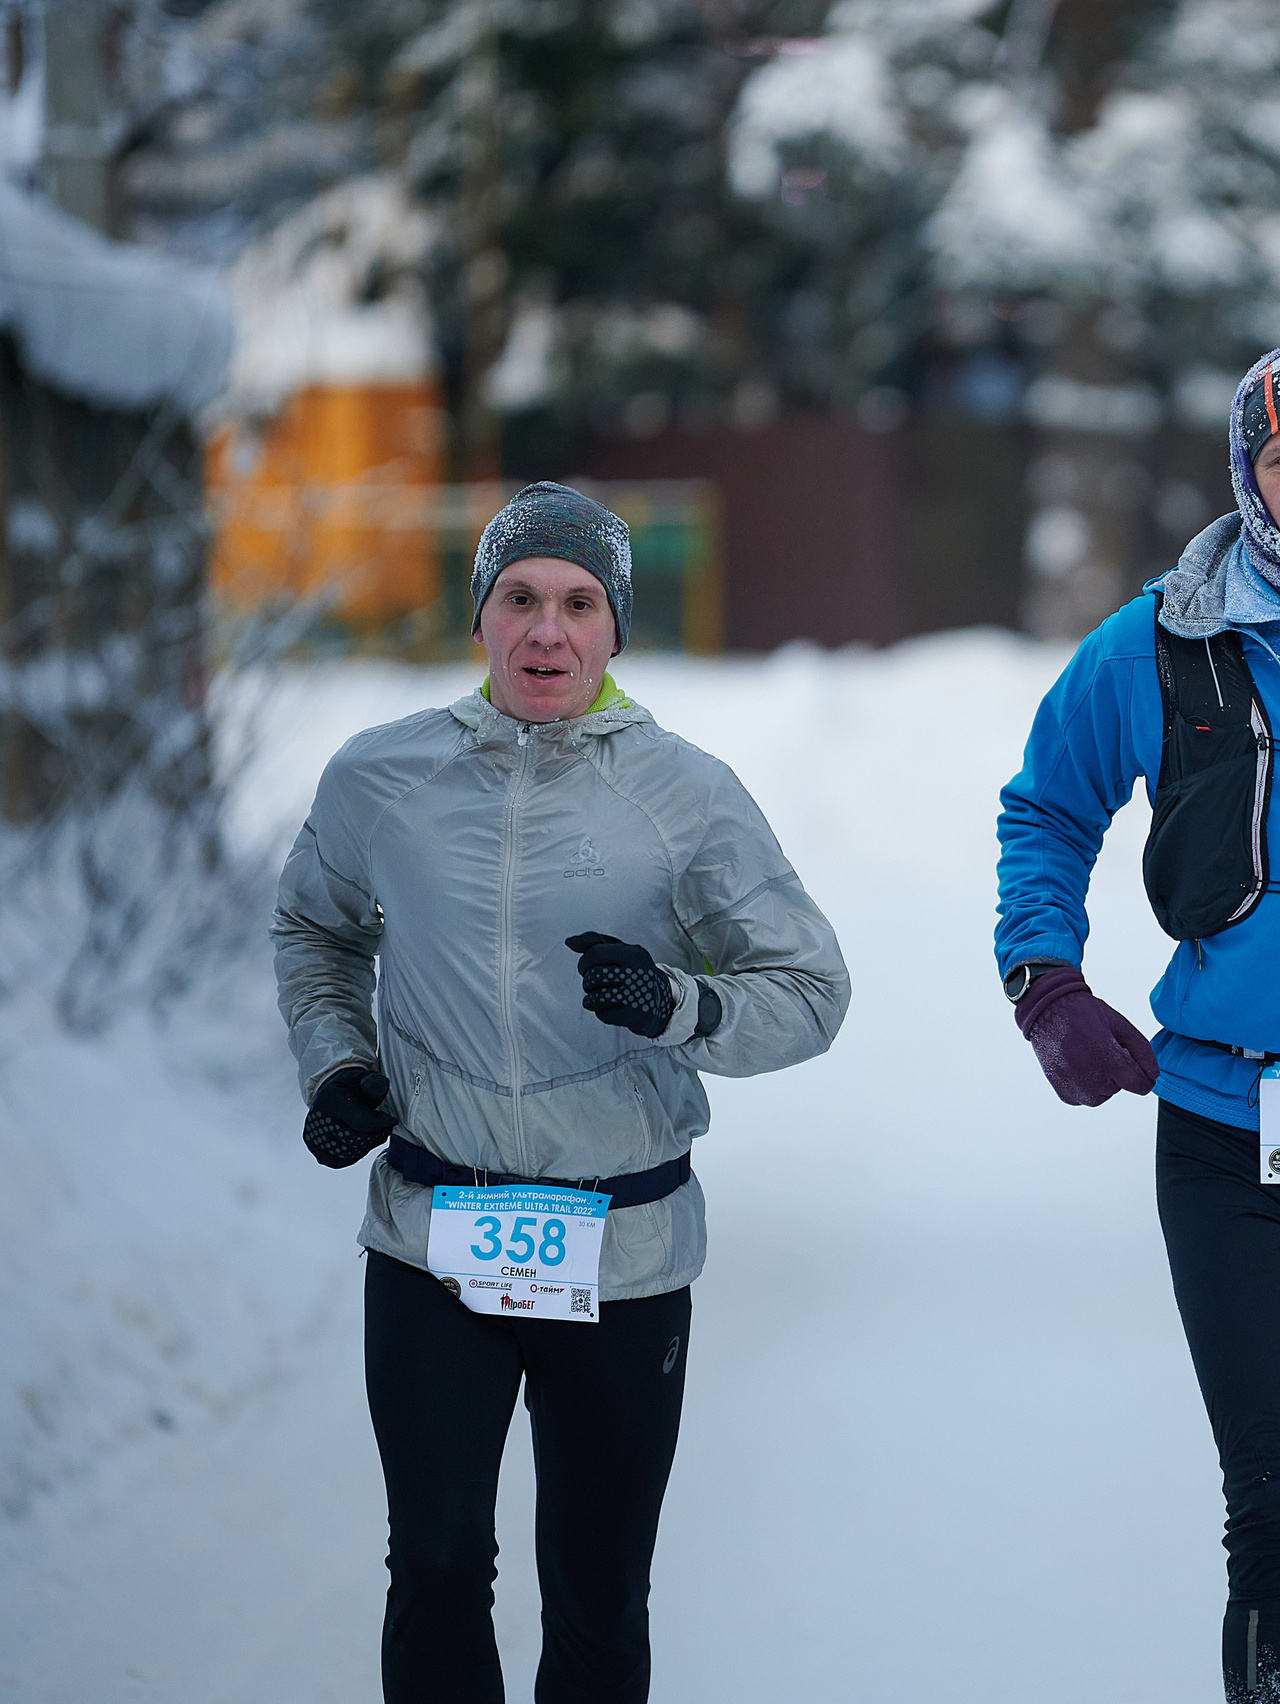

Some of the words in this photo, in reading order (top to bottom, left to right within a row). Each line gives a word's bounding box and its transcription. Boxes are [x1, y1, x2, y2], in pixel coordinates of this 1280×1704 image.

[458, 1191, 474, 1199] 2-й
[476, 1190, 509, 1200] зимний
[511, 1191, 587, 1204] ультрамарафон
[483, 1201, 522, 1210] EXTREME
[524, 1202, 549, 1211] ULTRA
[551, 1204, 571, 1213] TRAIL
[470, 1215, 566, 1267] 358
[501, 1266, 537, 1278] СЕМЕН
[508, 1299, 535, 1310] ПроБЕГ
